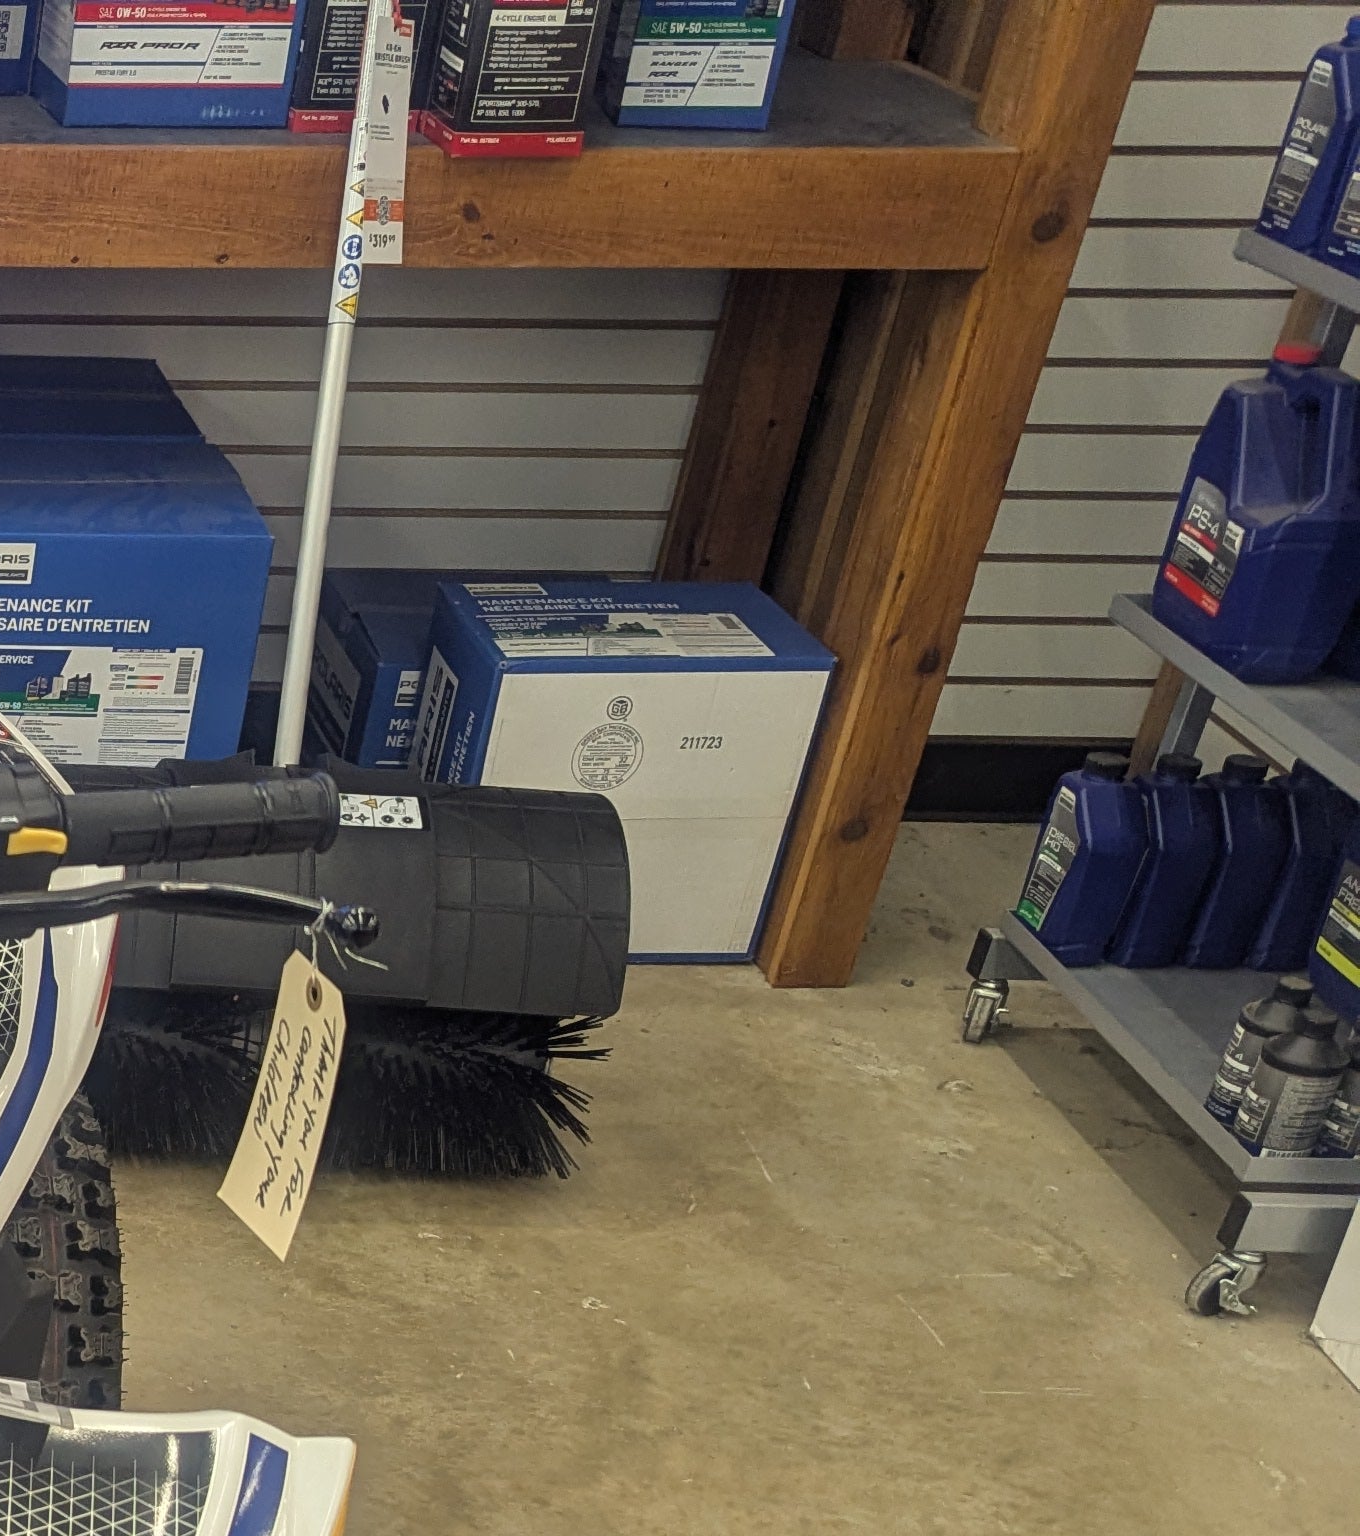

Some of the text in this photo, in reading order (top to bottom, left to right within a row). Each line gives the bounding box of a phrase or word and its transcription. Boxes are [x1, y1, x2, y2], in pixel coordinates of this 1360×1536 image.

[99, 7, 115, 18] SAE
[116, 7, 147, 18] 0W-50
[651, 22, 669, 34] SAE
[669, 22, 703, 34] 5W-50
[65, 599, 93, 613] KIT
[680, 736, 723, 750] 211723
